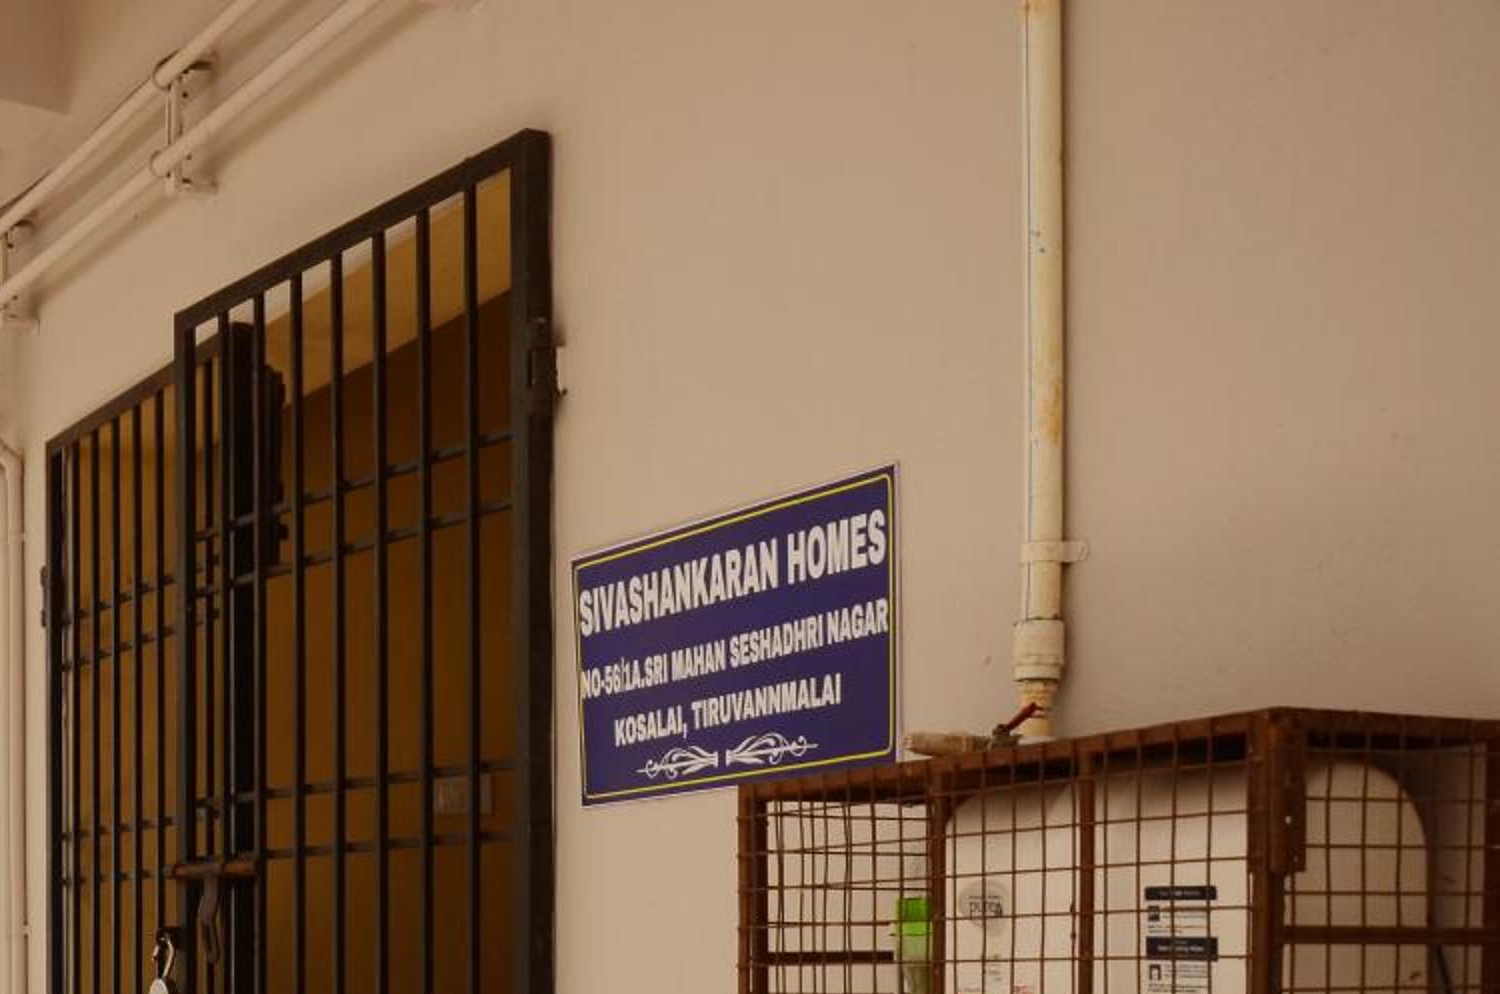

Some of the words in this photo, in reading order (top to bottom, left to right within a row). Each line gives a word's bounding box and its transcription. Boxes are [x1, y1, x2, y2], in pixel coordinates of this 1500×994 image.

[580, 538, 779, 637] SIVASHANKARAN
[787, 509, 886, 584] HOMES
[671, 639, 726, 681] MAHAN
[730, 613, 824, 669] SESHADHRI
[827, 598, 888, 645] NAGAR
[615, 704, 687, 747] KOSALAI,
[691, 672, 841, 729] TIRUVANNMALAI
